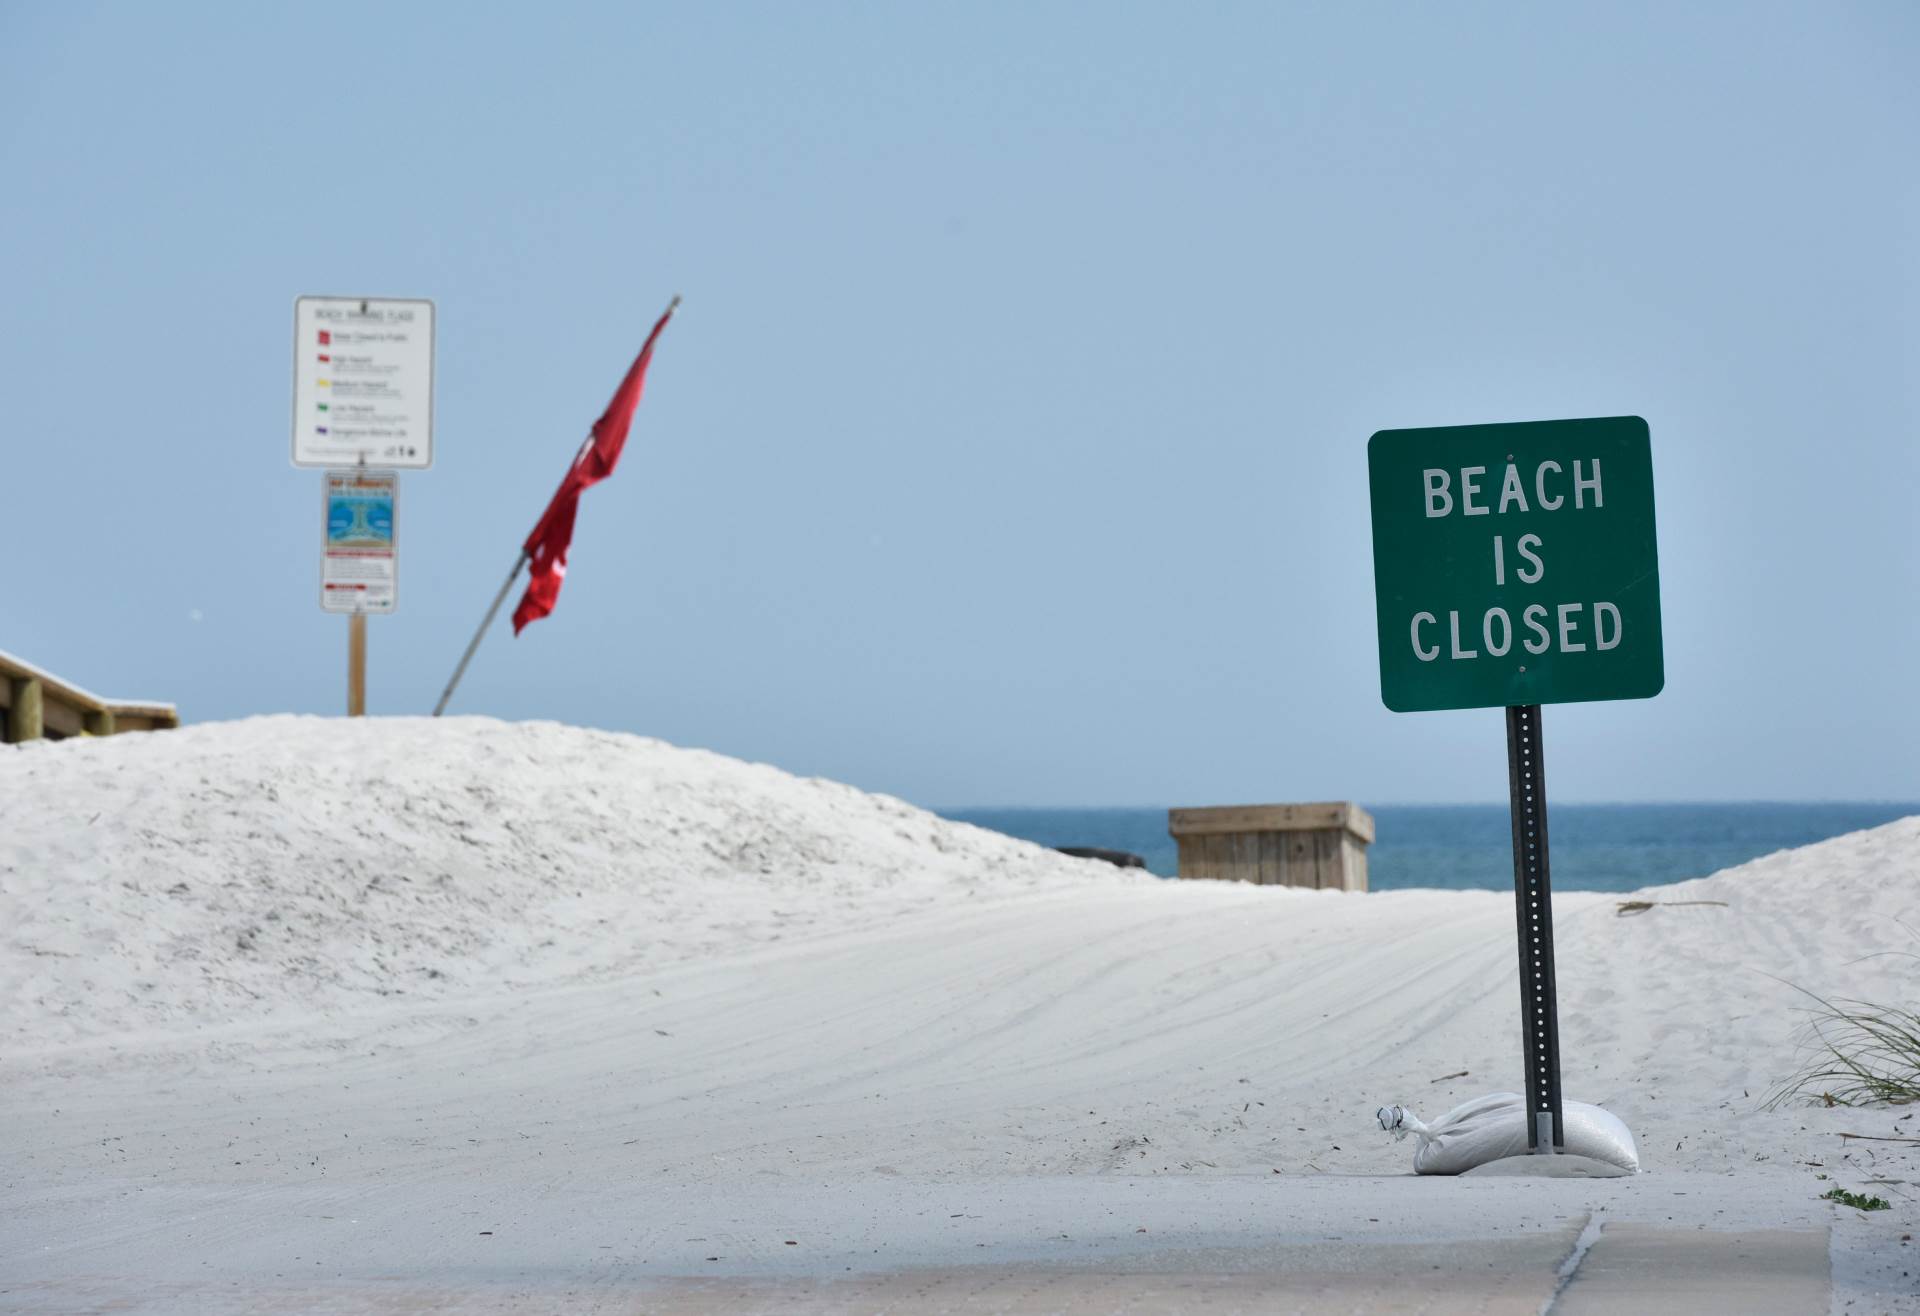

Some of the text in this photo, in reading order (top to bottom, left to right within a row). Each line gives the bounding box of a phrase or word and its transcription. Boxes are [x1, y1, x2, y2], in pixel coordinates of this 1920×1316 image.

[1423, 458, 1603, 518] BEACH
[1493, 533, 1544, 586] IS
[1410, 601, 1622, 662] CLOSED
